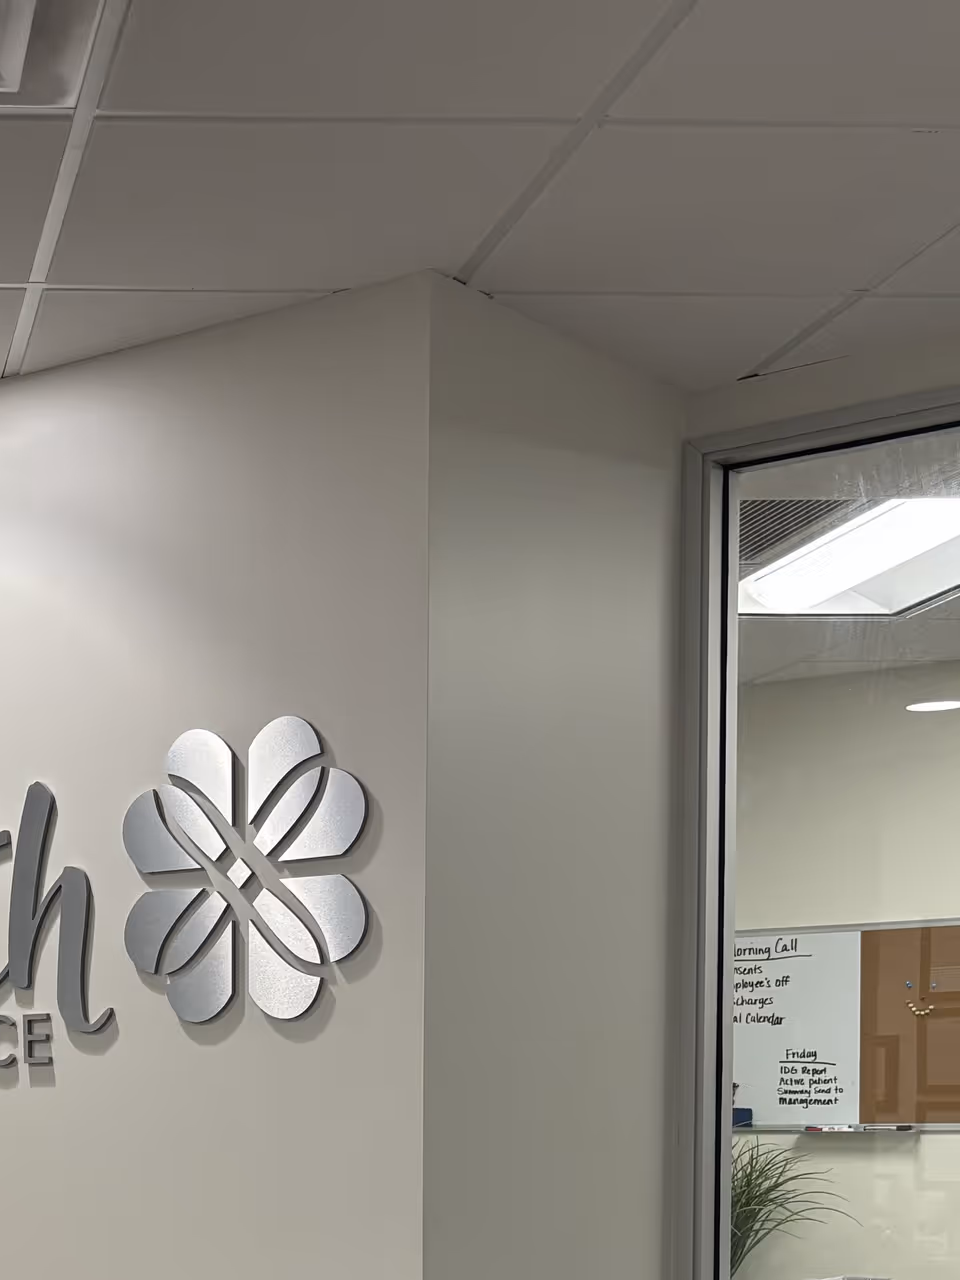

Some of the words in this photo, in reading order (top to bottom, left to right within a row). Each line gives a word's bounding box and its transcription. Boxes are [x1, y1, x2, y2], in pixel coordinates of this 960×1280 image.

[734, 944, 771, 960] orning
[775, 937, 798, 954] Call
[745, 1012, 786, 1026] Calendar
[786, 1048, 817, 1062] Friday
[780, 1066, 798, 1075] IDG
[801, 1066, 827, 1077] Report
[779, 1077, 805, 1086] Active
[809, 1076, 838, 1088] patient
[834, 1086, 844, 1094] to
[779, 1097, 839, 1109] management
